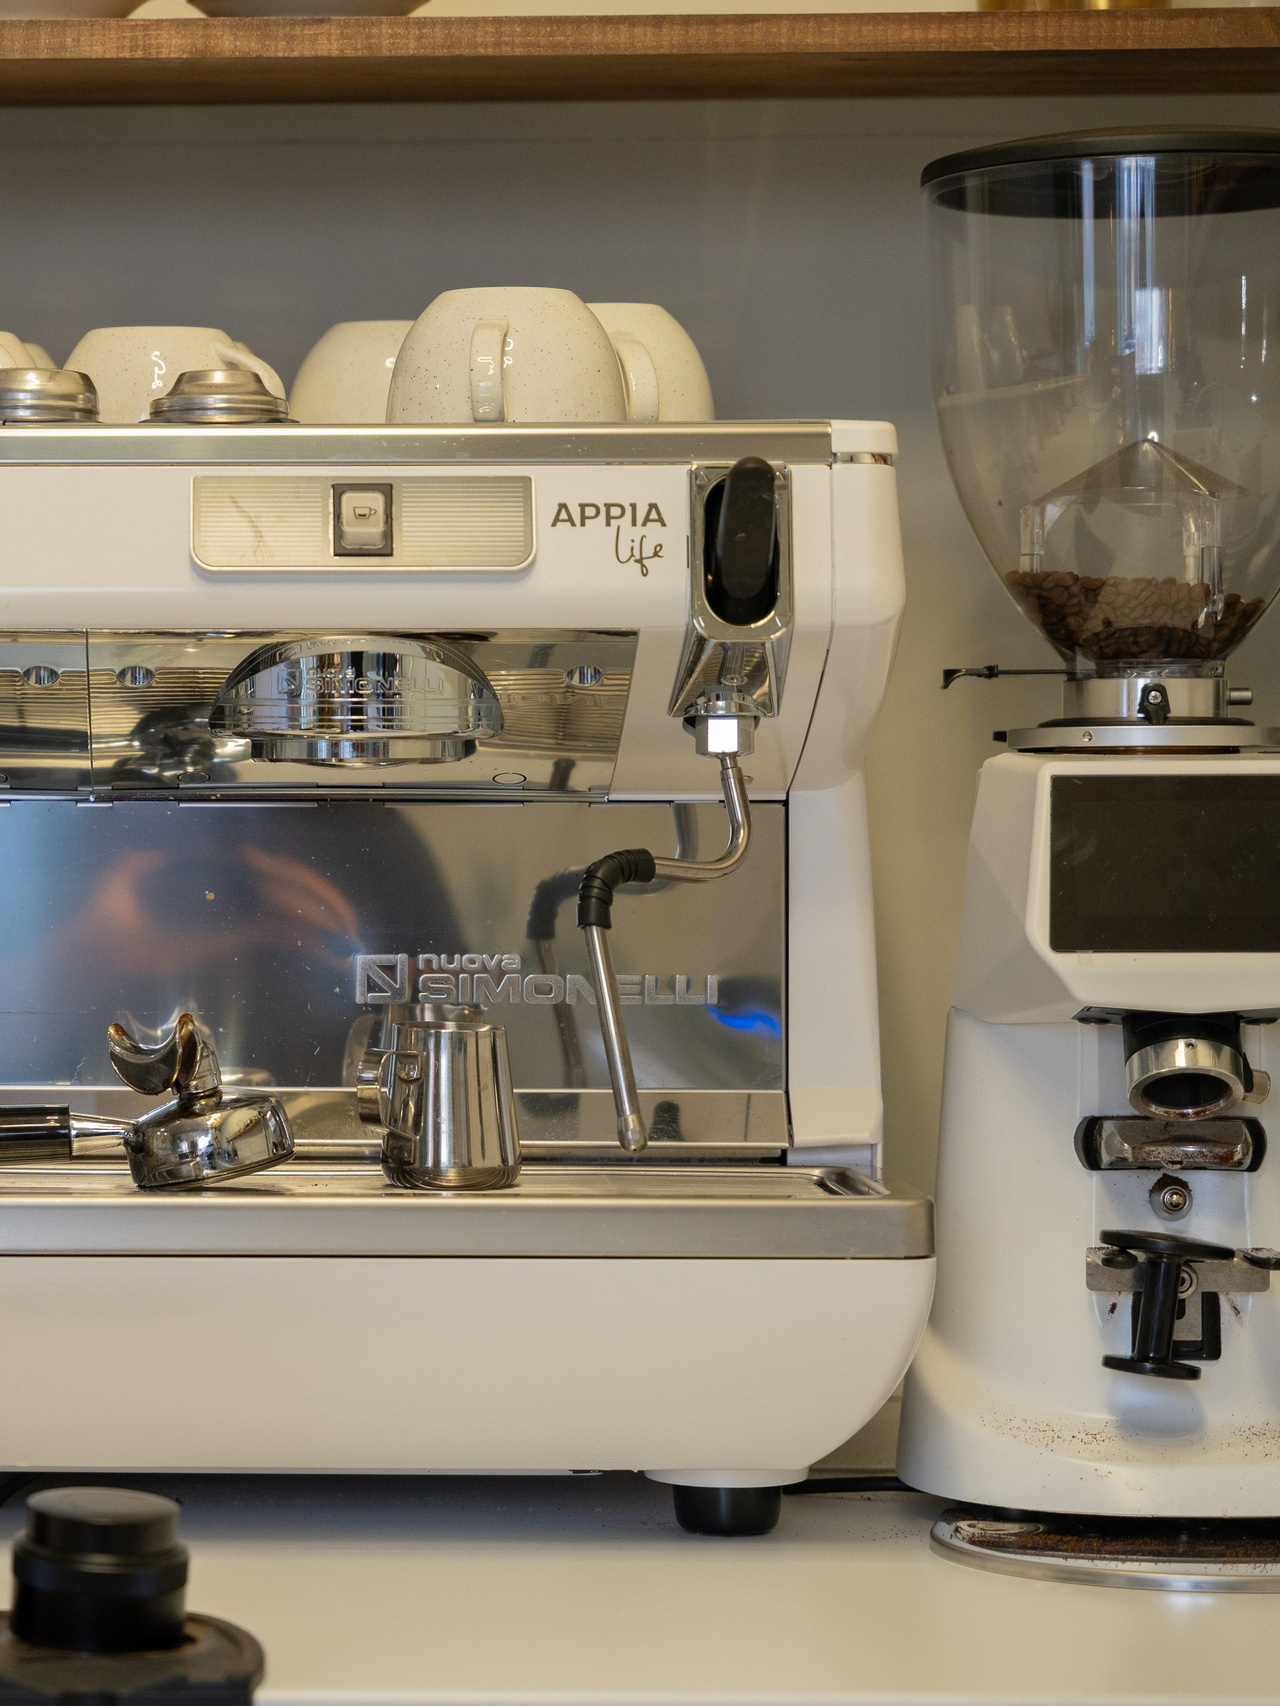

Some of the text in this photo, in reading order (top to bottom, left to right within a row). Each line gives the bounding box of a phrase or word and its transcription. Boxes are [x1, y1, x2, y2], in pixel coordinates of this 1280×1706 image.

[551, 502, 667, 527] APPIA
[615, 525, 665, 577] life
[418, 953, 521, 971] nuova
[418, 974, 719, 1005] SIMONELLI
